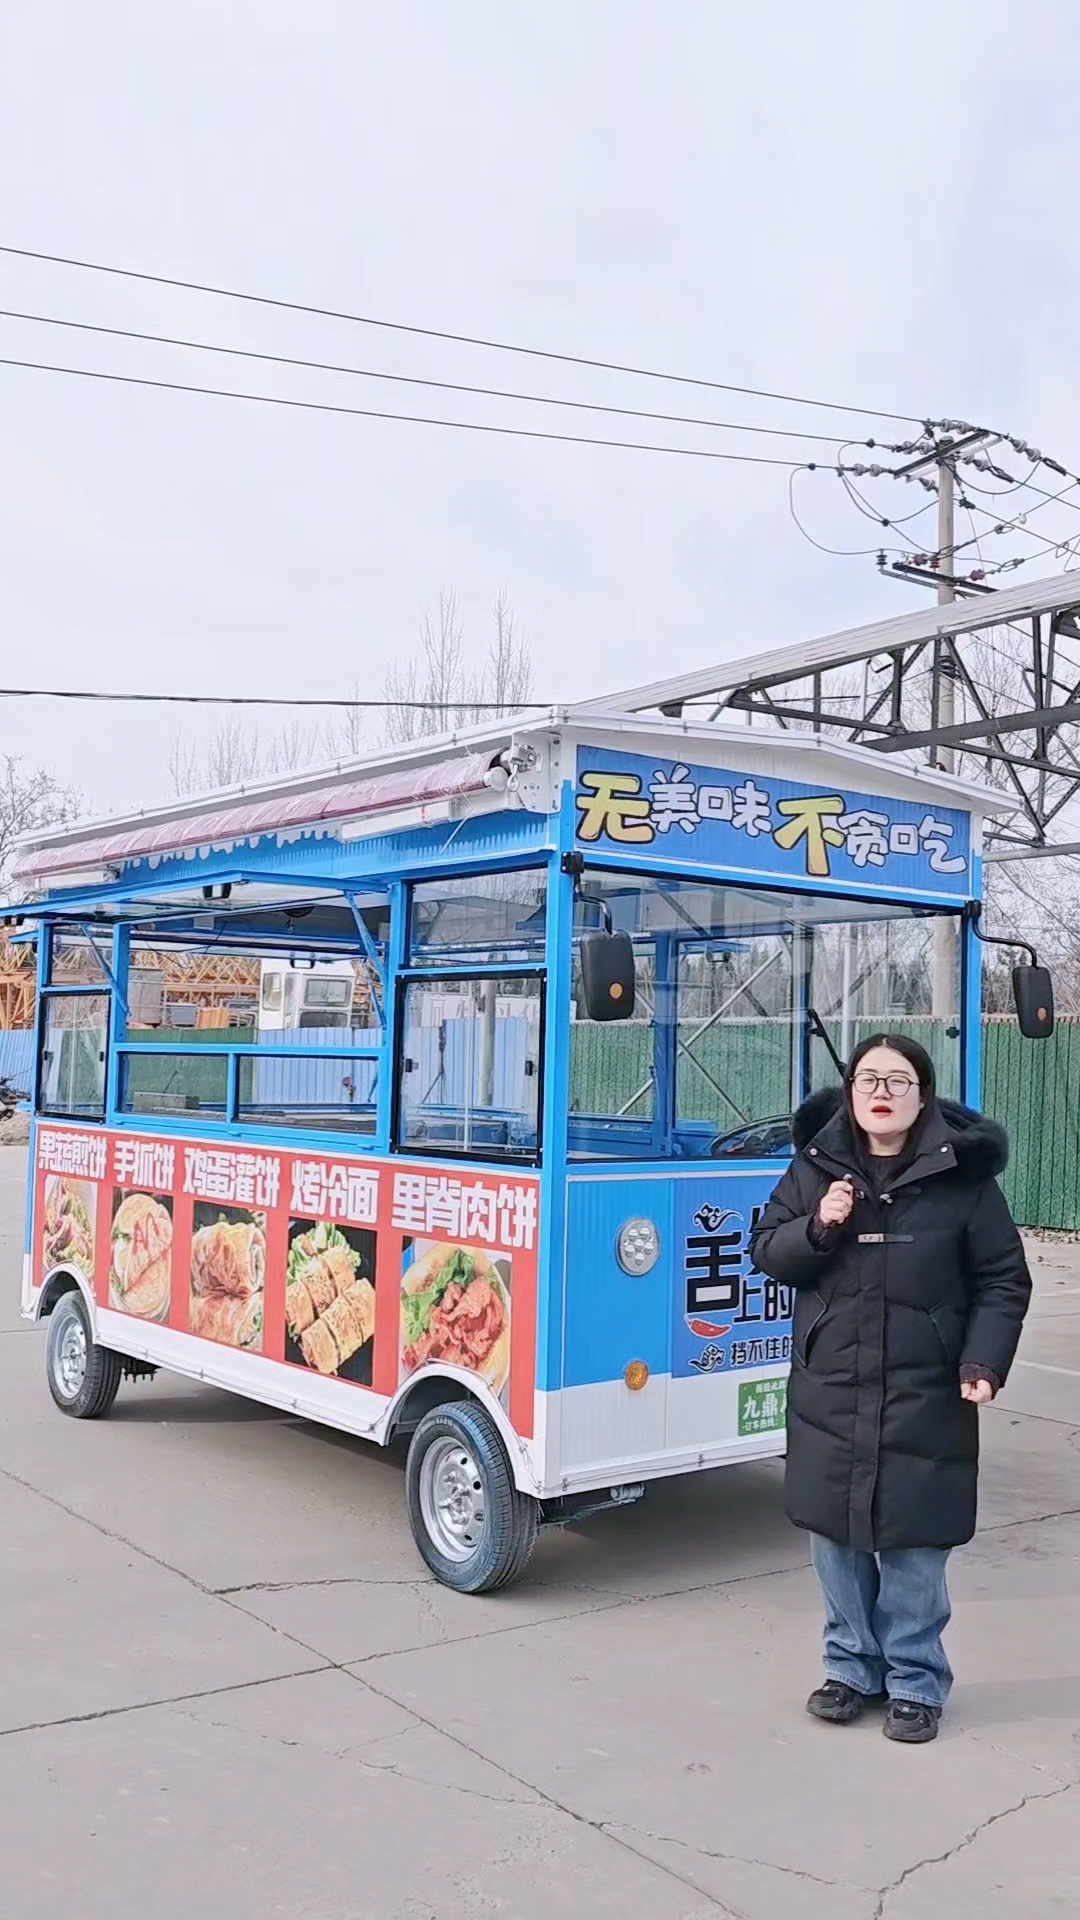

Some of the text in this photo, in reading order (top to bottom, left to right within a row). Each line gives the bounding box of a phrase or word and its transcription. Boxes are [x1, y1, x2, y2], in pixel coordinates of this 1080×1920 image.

[576, 764, 968, 877] 无美味不贪吃
[39, 1130, 537, 1249] 果蔬煎饼 手抓饼 鸡蛋灌饼 烤冷面 里脊肉饼
[742, 1393, 787, 1420] 九鼎
